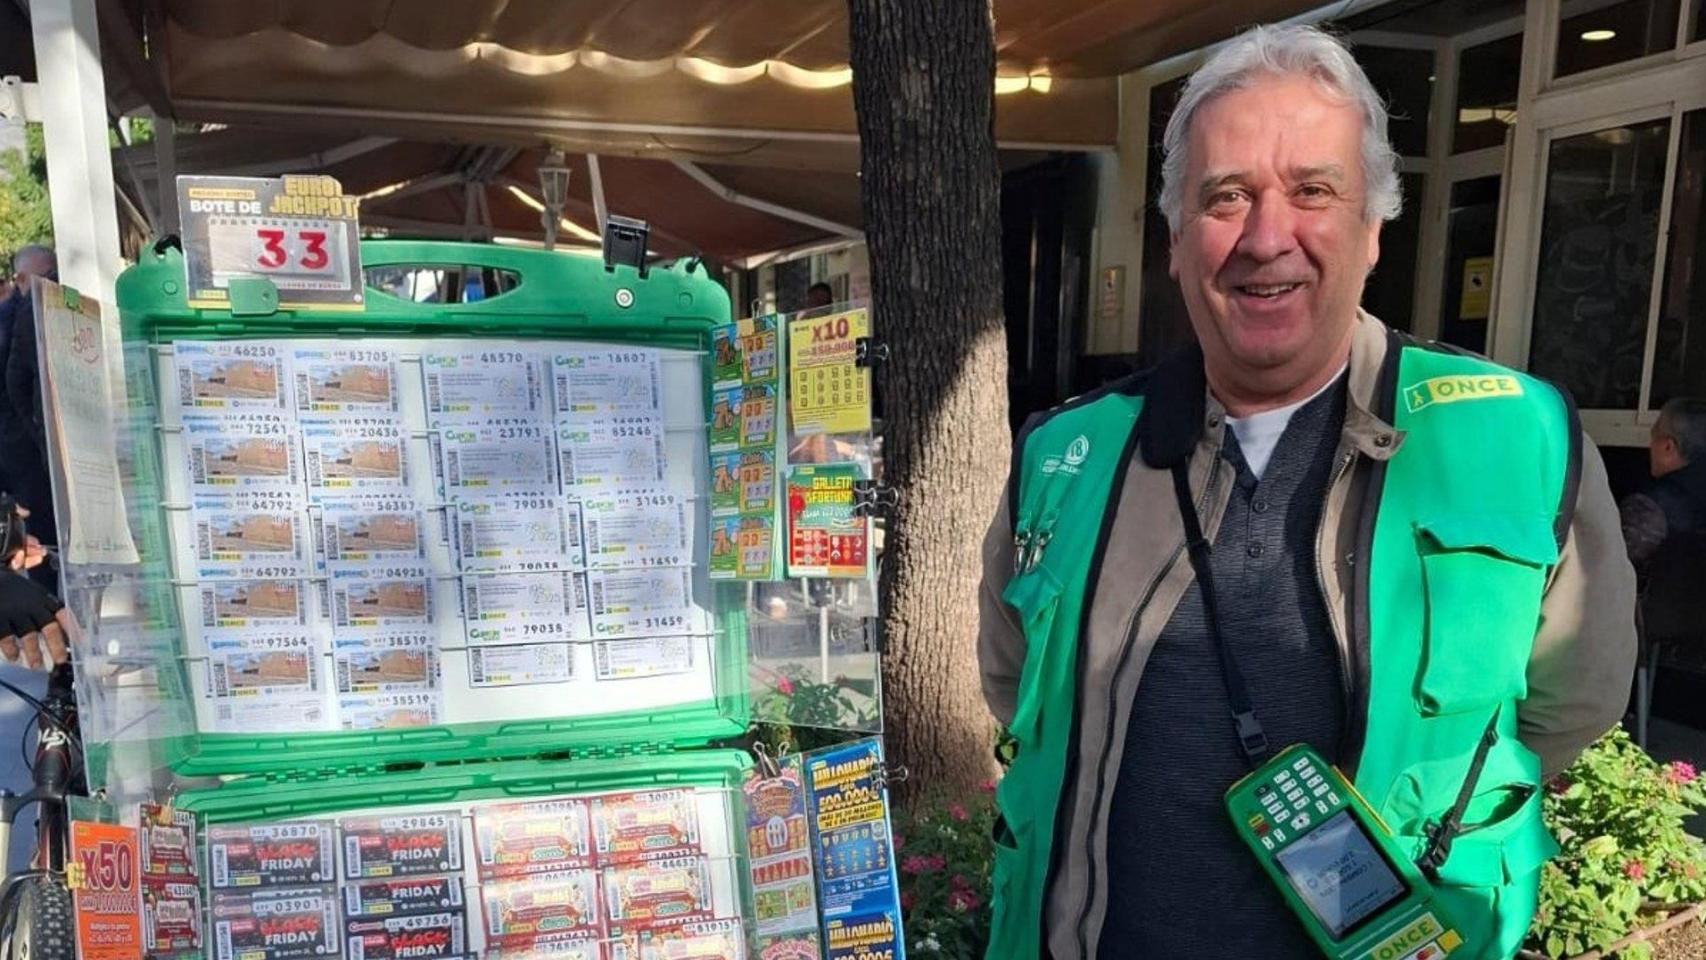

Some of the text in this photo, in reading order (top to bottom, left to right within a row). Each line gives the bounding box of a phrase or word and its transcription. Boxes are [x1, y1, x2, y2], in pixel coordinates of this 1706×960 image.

[285, 177, 334, 196] EURO
[190, 200, 262, 213] BOTE DE
[257, 230, 329, 269] 33
[1437, 378, 1515, 397] ONCE
[256, 567, 297, 577] 64792
[523, 622, 564, 634] 79038
[645, 616, 684, 628] 31459
[267, 636, 308, 647] 97564
[389, 635, 427, 646] 38519
[402, 817, 445, 829] 29845
[271, 827, 318, 838] 36870
[392, 847, 442, 861] FRIDAY
[260, 857, 315, 871] FRIDAY
[392, 884, 442, 898] FRIDAY
[275, 898, 321, 912] 03901
[406, 916, 449, 928] 49756
[265, 930, 318, 945] FRIDAY
[1378, 920, 1435, 960] ONCE
[395, 944, 446, 958] FRIDAY
